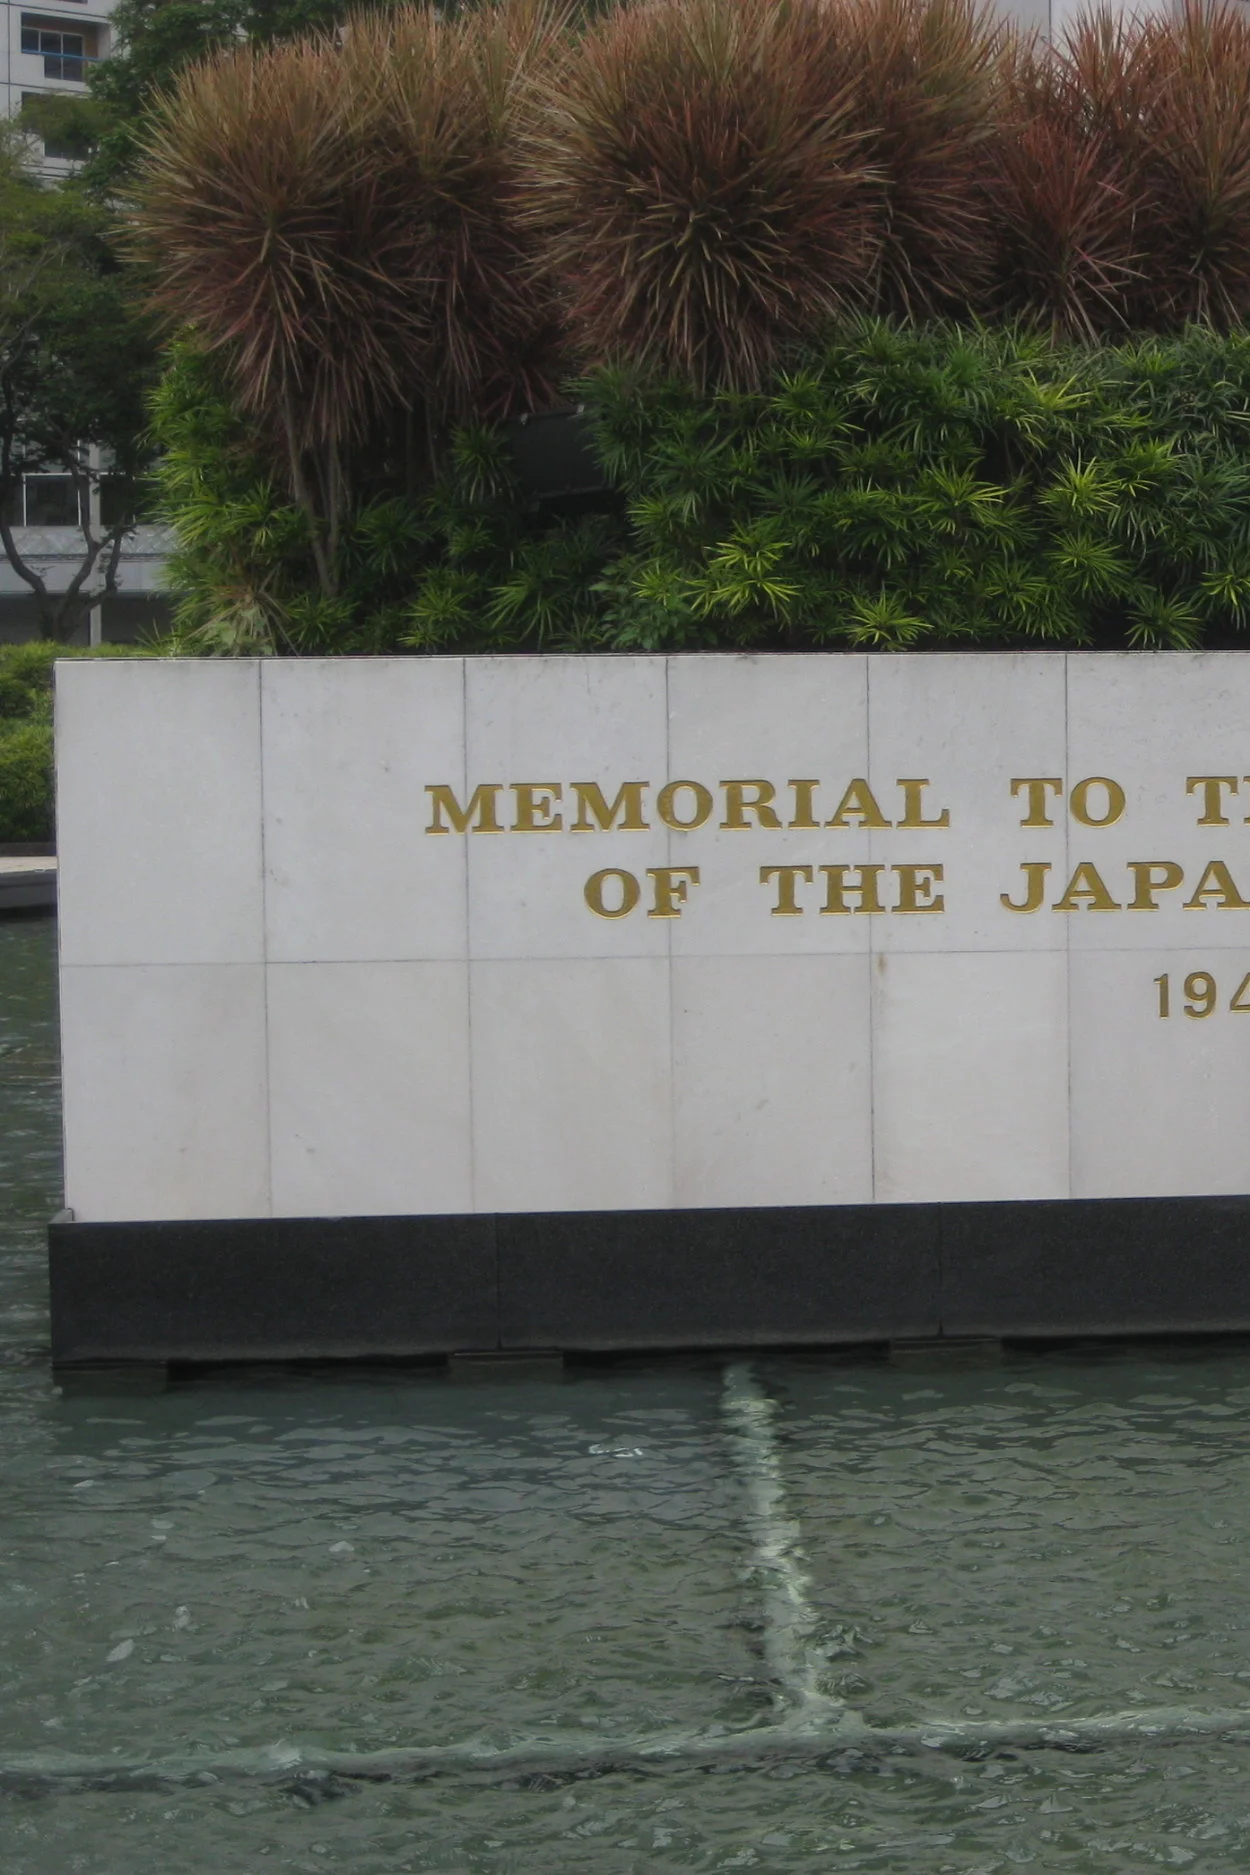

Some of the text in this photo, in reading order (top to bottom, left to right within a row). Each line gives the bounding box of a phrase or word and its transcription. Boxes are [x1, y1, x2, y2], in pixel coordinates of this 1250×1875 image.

[424, 777, 950, 834] MEMORIAL
[1011, 776, 1125, 827] TO
[584, 866, 700, 920] OF
[759, 863, 944, 916] THE
